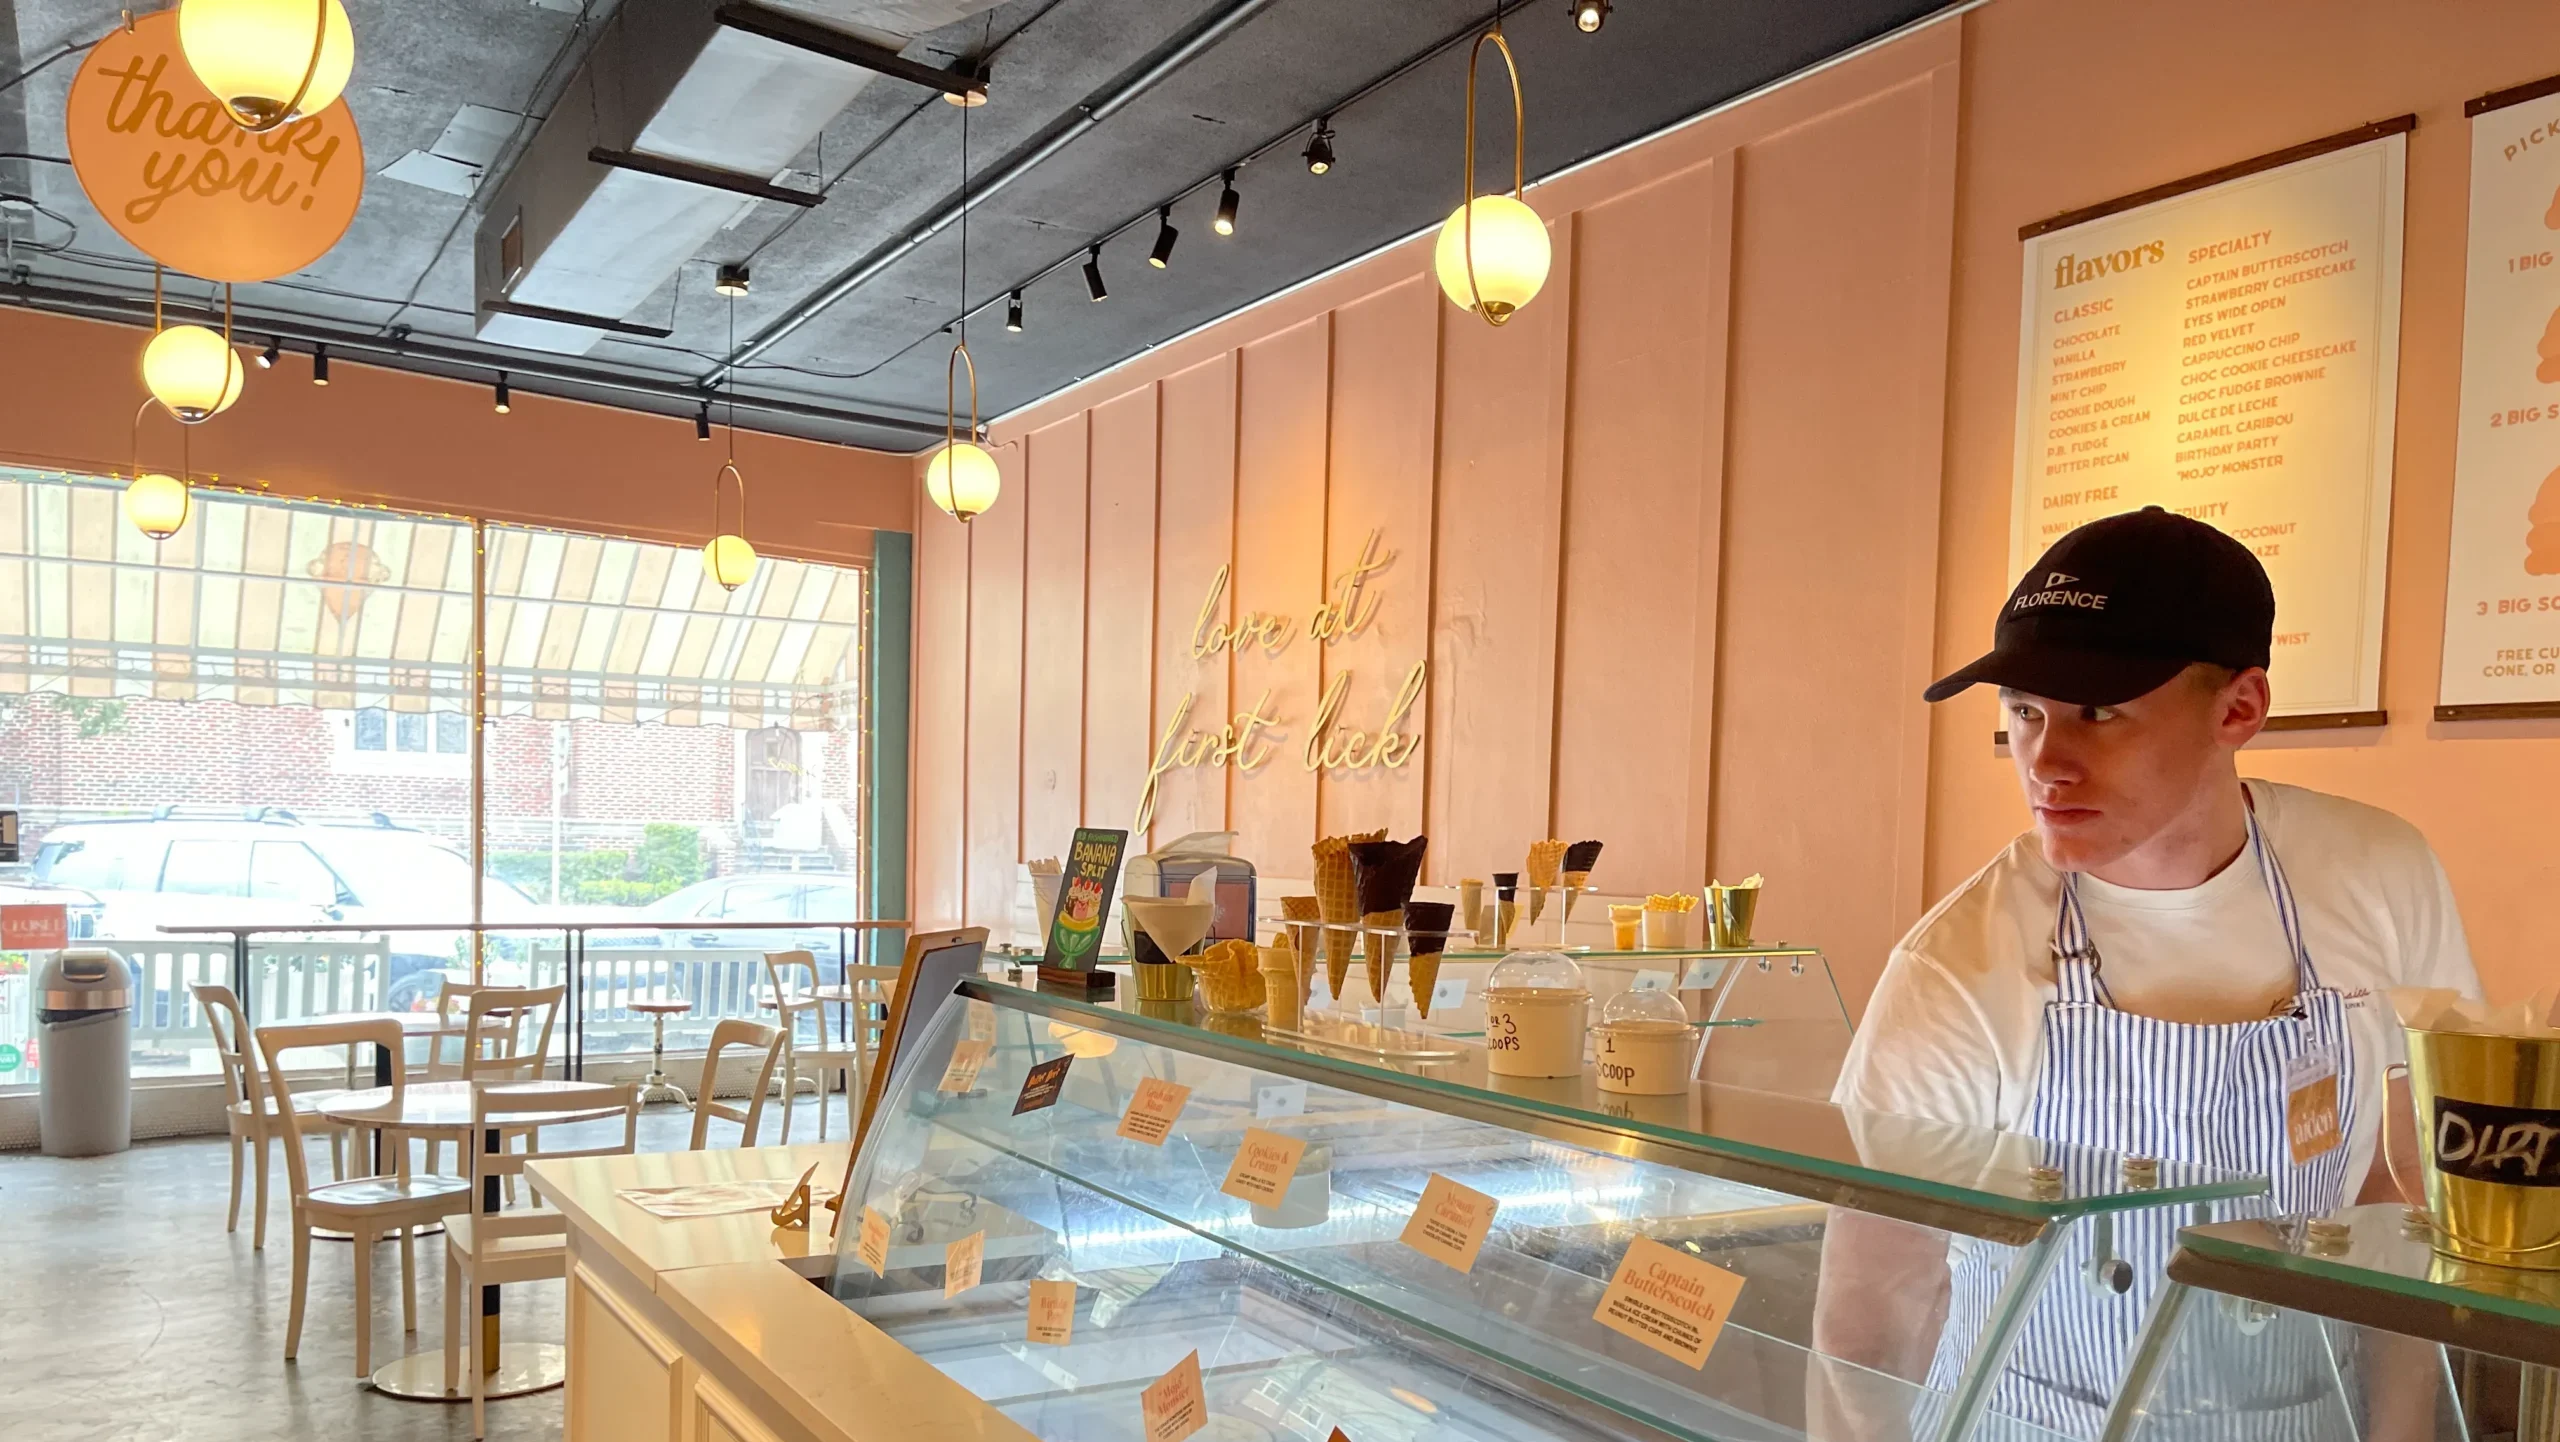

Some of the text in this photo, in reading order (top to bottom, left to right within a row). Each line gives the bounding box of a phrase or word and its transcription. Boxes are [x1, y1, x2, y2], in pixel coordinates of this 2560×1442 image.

[2503, 118, 2560, 162] PICK
[125, 136, 340, 223] you!
[2188, 229, 2272, 264] SPECIALTY
[2054, 240, 2165, 290] flavors
[2186, 239, 2349, 291] CAPTAIN BUTTERSCOTCH
[2508, 251, 2553, 273] 1 BIG
[2185, 258, 2357, 310] STRAWBERRY CHEESECAKE
[2054, 298, 2114, 324] CLASSIC
[2183, 295, 2287, 329] EYES WIDE OPEN
[2053, 324, 2121, 349] CHOCOLATE
[2182, 322, 2256, 349] RED VELVET
[2052, 348, 2096, 368] VANILLA
[2181, 331, 2301, 367] CAPPUCCINO CHIP
[2051, 360, 2127, 386] STRAWBERRY
[2180, 339, 2357, 387] CHOC COOKIE CHEESECAKE
[2050, 382, 2108, 405] MINT CHIP
[2179, 366, 2327, 406] CHOC FUDGE BROWNIE
[2049, 394, 2136, 422] COOKIE DOUGH
[2178, 395, 2279, 425] DULCE DE LECHE
[2490, 412, 2503, 429] 2
[2507, 406, 2541, 426] BIG
[2048, 421, 2098, 440] COOKIES
[2111, 410, 2151, 427] CREAM
[2176, 412, 2294, 444] CARAMEL CARIBOU
[2071, 437, 2109, 454] FUDGE
[2175, 435, 2280, 464] BIRTHDAY PARTY
[2046, 451, 2130, 476] BUTTER PECAN
[2221, 454, 2284, 475] MONSTER
[2043, 485, 2119, 510] DAIRY FREE
[2175, 501, 2229, 519] RUITY
[2231, 522, 2297, 539] COCONUT
[2252, 544, 2280, 557] AZE
[1191, 528, 1391, 660] love at
[2013, 590, 2109, 611] FLORENCE
[2476, 601, 2489, 616] 3
[2498, 597, 2532, 615] BIG
[2272, 632, 2311, 646] WIST
[2496, 647, 2534, 661] FREE
[2482, 662, 2556, 678] CONE, OR
[1134, 659, 1427, 836] first lick
[1073, 841, 1118, 867] BANANA
[1080, 861, 1108, 879] SPLIT
[1490, 1015, 1501, 1027] OR
[1502, 1013, 1517, 1035] 3
[1488, 1036, 1520, 1051] OOPS
[1605, 1037, 1616, 1053] 1
[1648, 1261, 1706, 1299] Captain
[1622, 1268, 1717, 1322] Butterscotch
